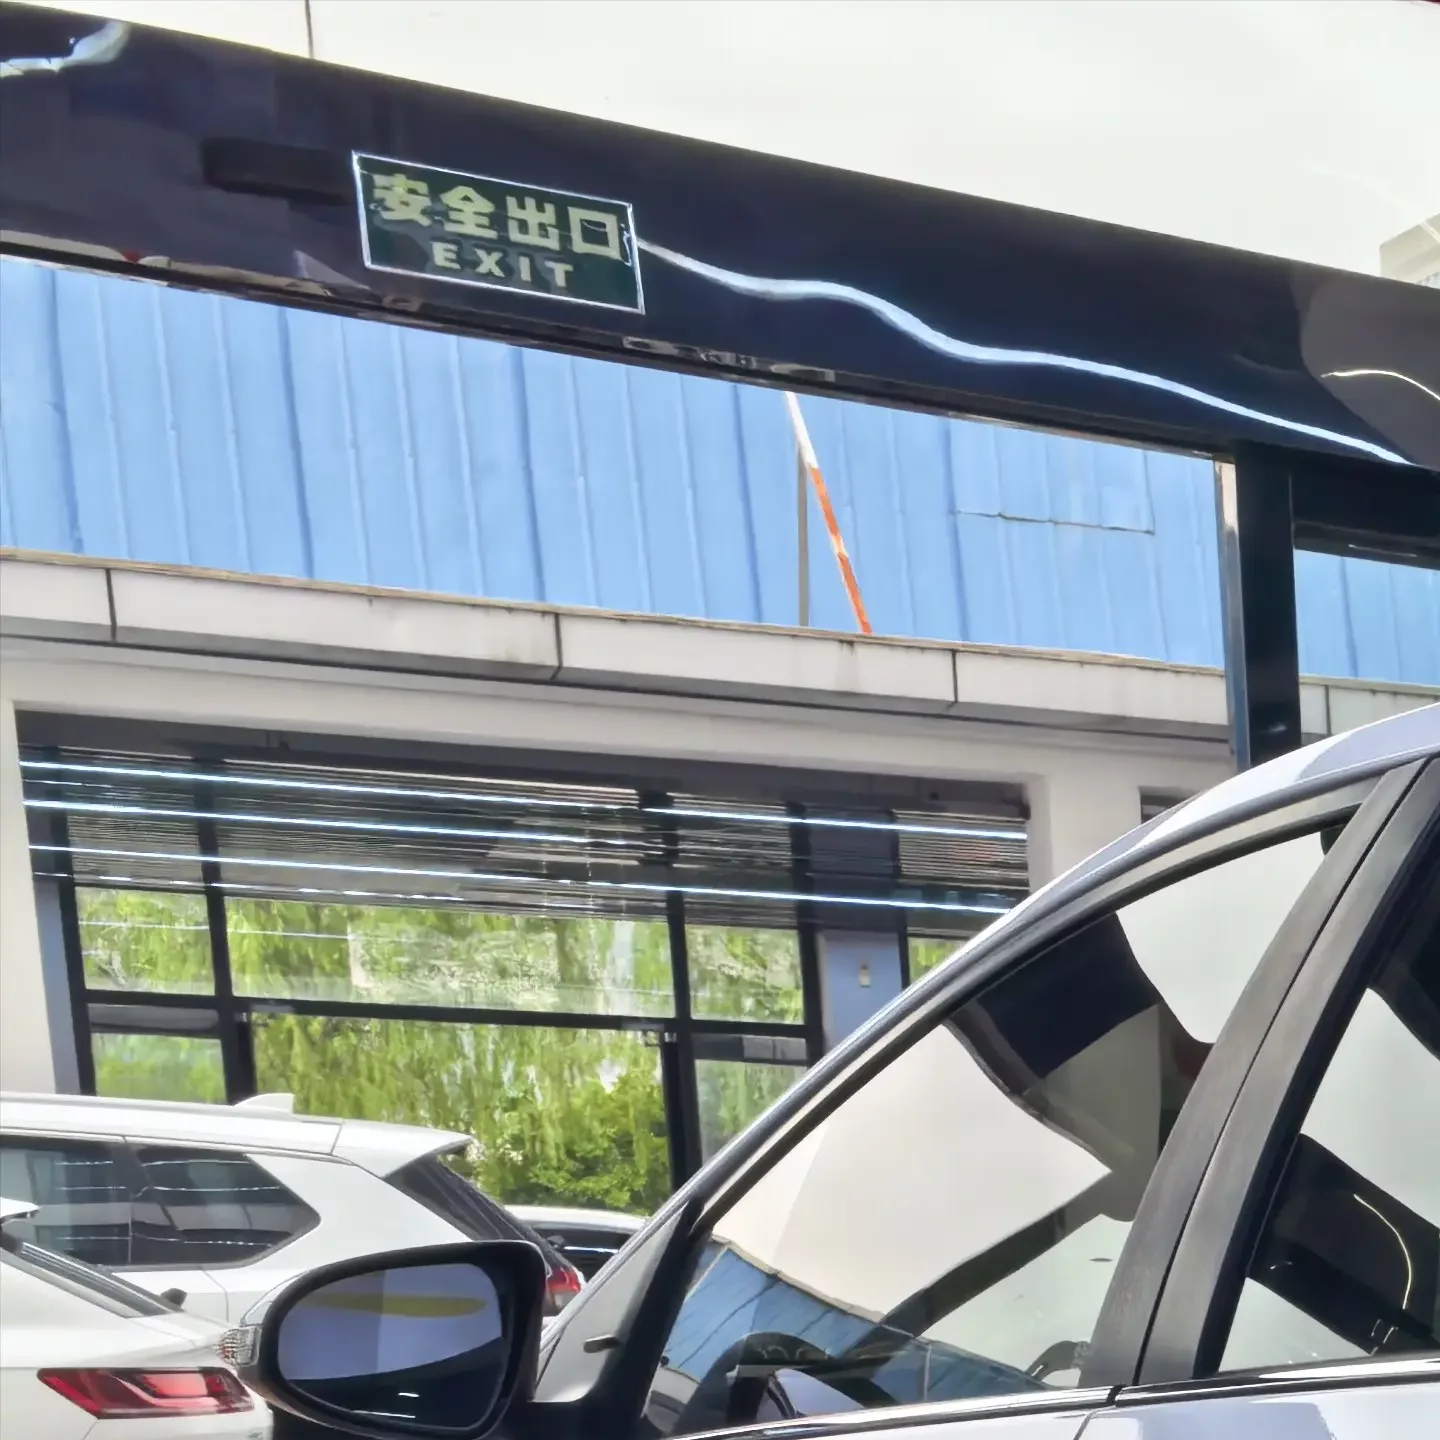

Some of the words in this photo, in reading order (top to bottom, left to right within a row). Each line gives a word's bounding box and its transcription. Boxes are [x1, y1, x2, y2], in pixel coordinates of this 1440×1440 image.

[372, 173, 621, 262] 安全出口
[432, 241, 574, 288] EXIT
